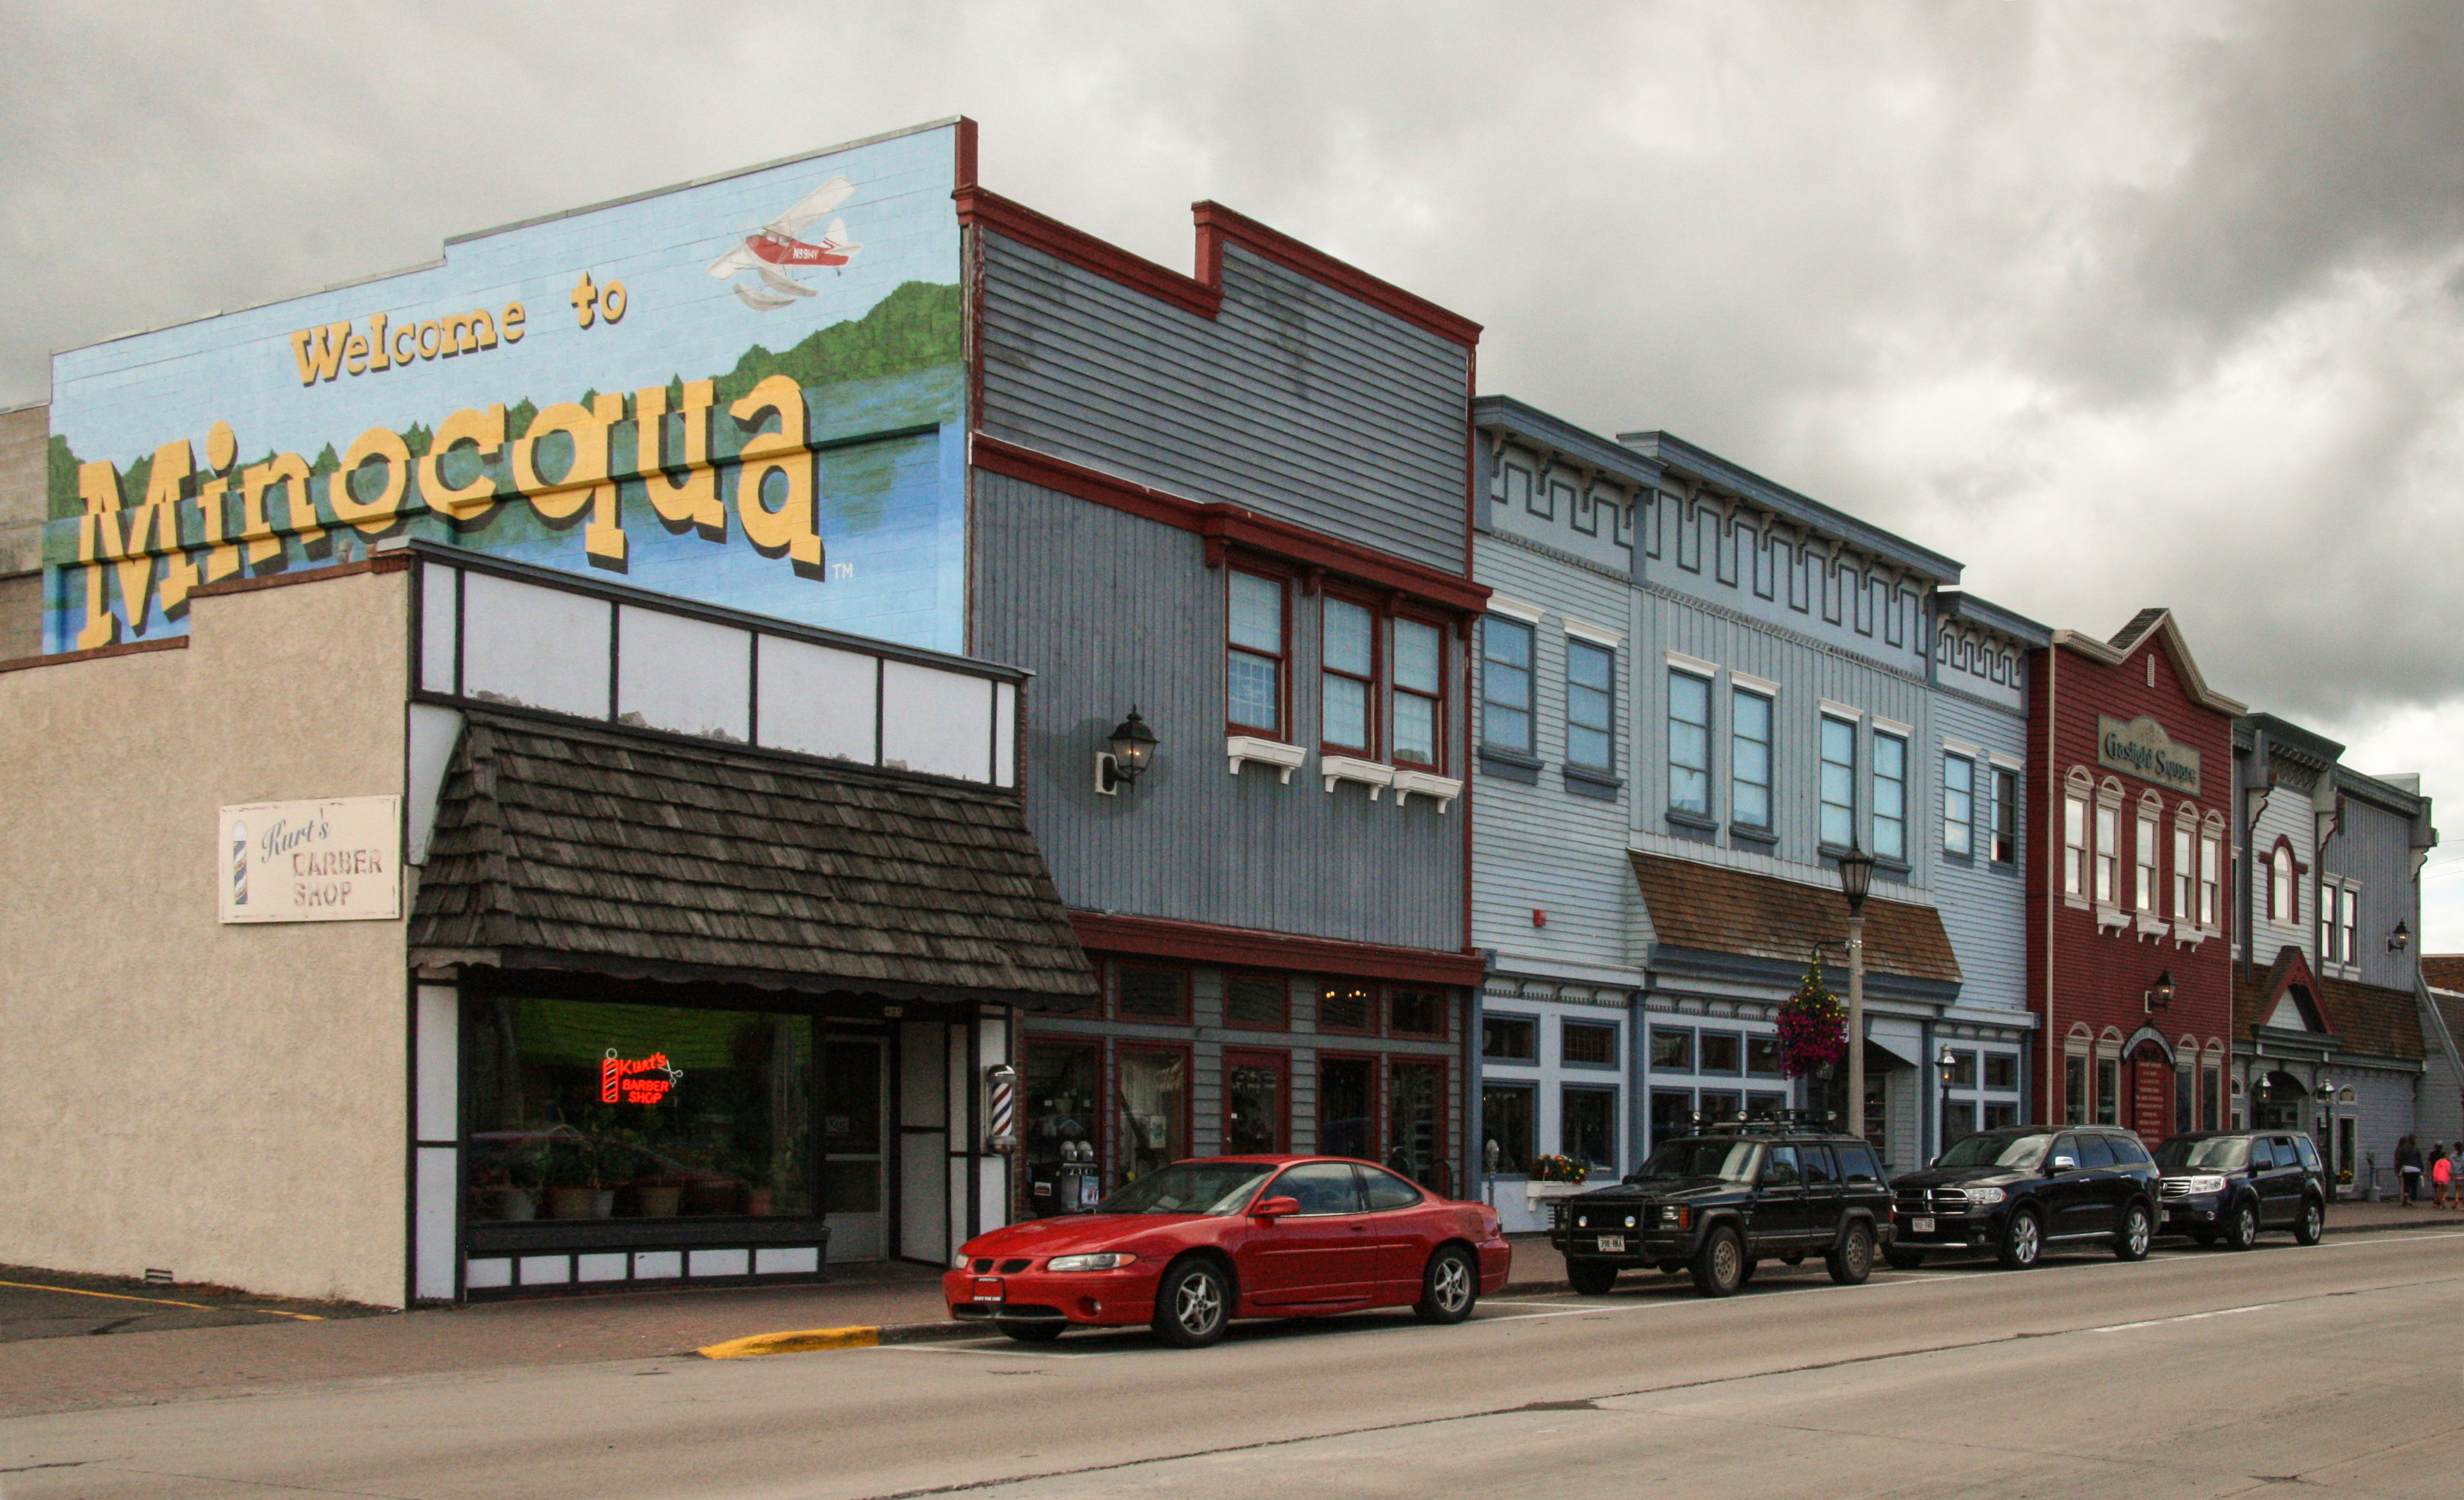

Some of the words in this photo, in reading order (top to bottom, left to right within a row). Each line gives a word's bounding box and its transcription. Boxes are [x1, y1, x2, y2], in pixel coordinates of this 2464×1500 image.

[289, 301, 525, 387] Welcome
[571, 271, 628, 329] to
[77, 375, 825, 650] Minocqua
[832, 563, 853, 579] TM
[2105, 733, 2154, 770] Gaslight
[2156, 749, 2197, 783] Square
[261, 808, 329, 863] Kurt's
[294, 882, 352, 907] SHOP
[619, 1052, 667, 1075] Kurt's
[622, 1079, 670, 1092] BARBER
[628, 1092, 664, 1103] SHOP
